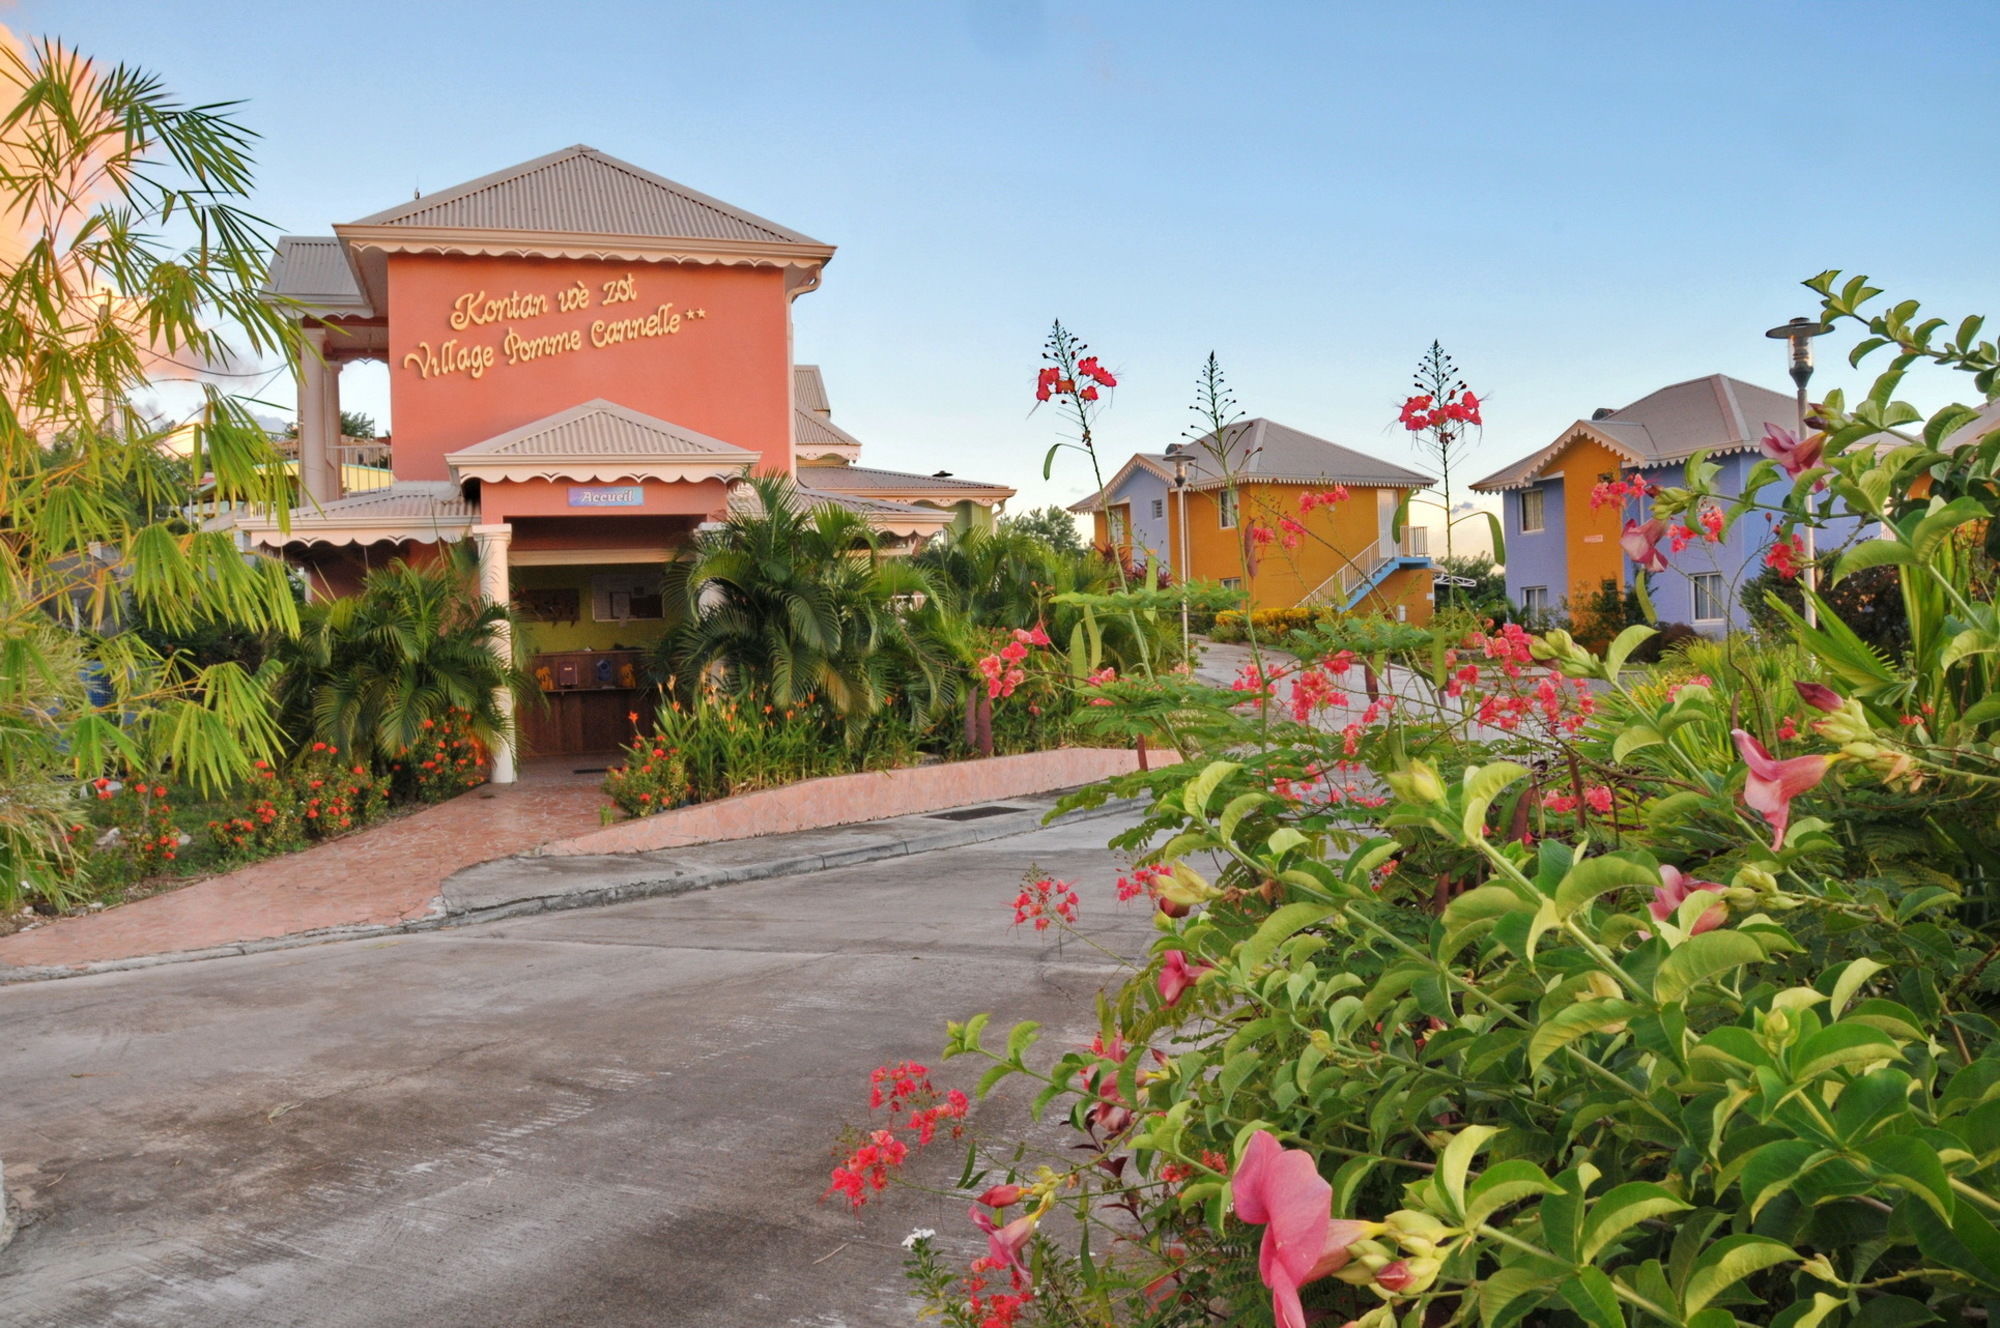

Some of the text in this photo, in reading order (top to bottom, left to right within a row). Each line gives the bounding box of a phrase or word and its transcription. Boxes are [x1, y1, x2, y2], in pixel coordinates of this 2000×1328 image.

[450, 273, 637, 331] Kontan wè zot
[403, 303, 681, 379] Village Pomme Cannelle
[581, 490, 634, 503] Accueil
